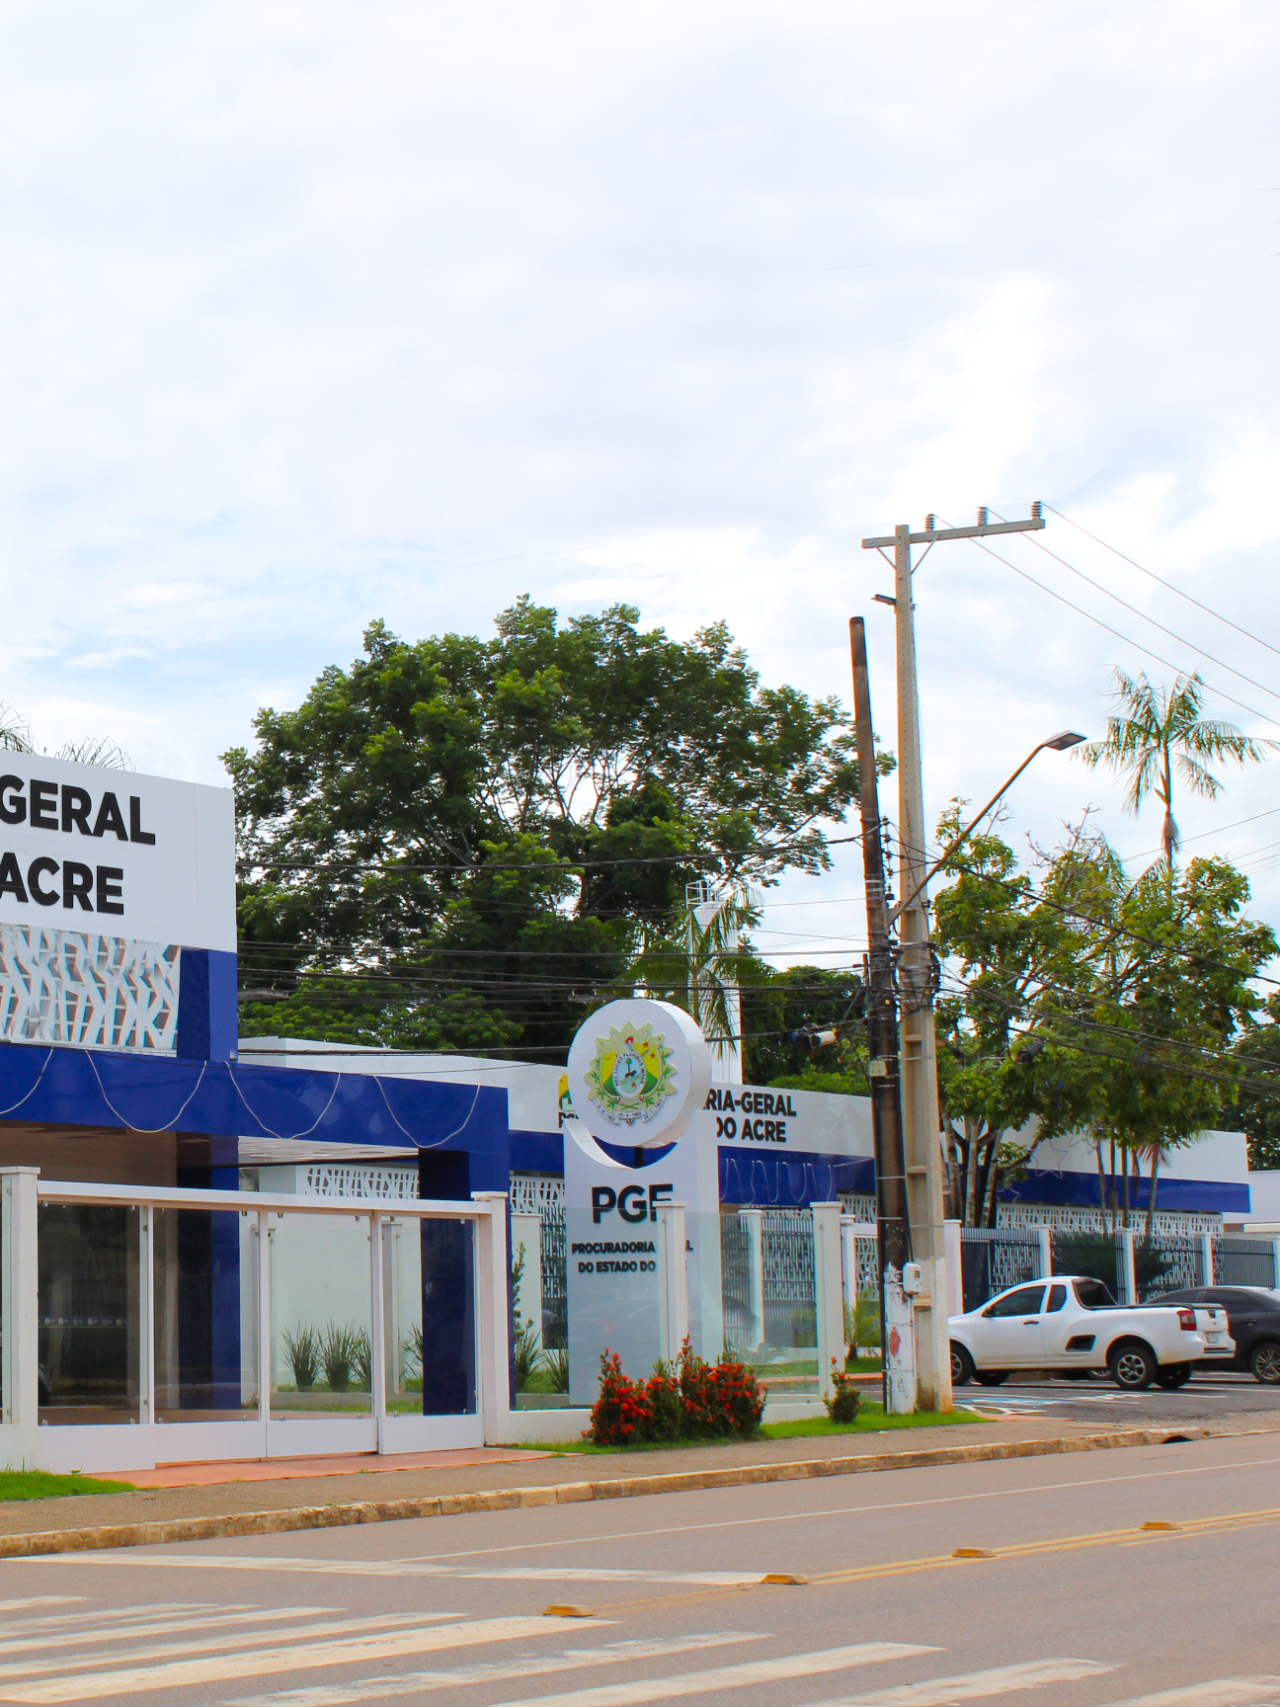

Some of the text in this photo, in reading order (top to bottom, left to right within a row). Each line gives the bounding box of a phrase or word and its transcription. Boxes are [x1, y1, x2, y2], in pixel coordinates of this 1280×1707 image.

[740, 1118, 787, 1143] ACRE
[571, 1241, 656, 1255] PROCURADORIA
[578, 1260, 656, 1273] DO ESTADO DO
